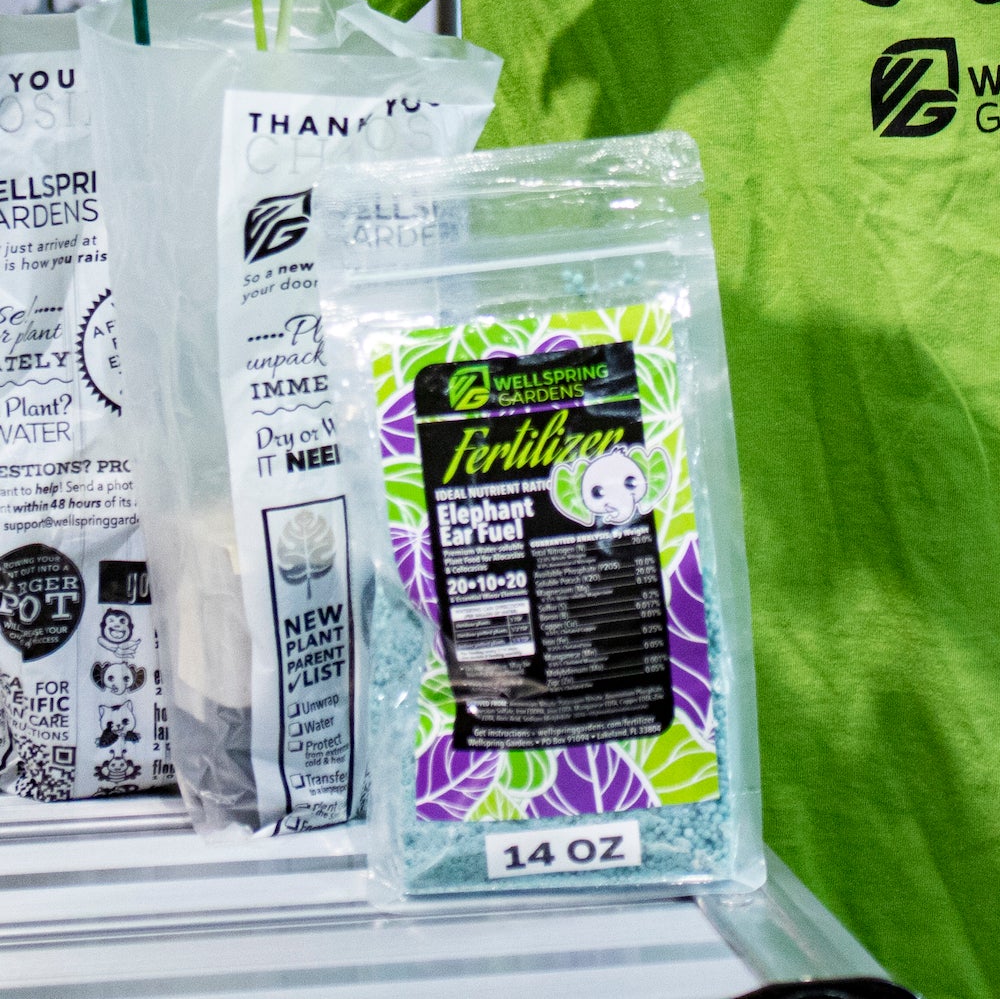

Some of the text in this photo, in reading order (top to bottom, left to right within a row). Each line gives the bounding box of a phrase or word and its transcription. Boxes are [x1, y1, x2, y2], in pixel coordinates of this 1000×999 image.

[8, 69, 75, 93] YOU
[386, 97, 440, 117] YO
[0, 170, 97, 202] ELLSPRI
[4, 234, 98, 258] just arrived at
[4, 250, 108, 272] is how you rais
[243, 260, 315, 288] So a new
[241, 283, 276, 306] your
[9, 321, 63, 355] plant
[0, 351, 71, 373] TELY
[246, 340, 328, 379] unpack
[250, 374, 329, 400] IMME
[492, 363, 609, 392] WELLSPRING
[5, 392, 73, 418] Plant?
[498, 384, 585, 407] GARDENS
[256, 426, 295, 451] Dry
[299, 429, 321, 443] or
[442, 408, 625, 485] Fertilizer
[257, 443, 342, 478] IT NEE
[21, 485, 33, 497] to
[35, 482, 63, 498] help!
[66, 480, 94, 493] Send
[97, 483, 104, 492] a
[107, 480, 134, 494] phot
[435, 488, 467, 502] IDEAL
[467, 483, 521, 499] NUTRIENT
[13, 500, 49, 514] within
[51, 499, 66, 510] 48
[68, 498, 101, 510] hours
[104, 496, 117, 508] of
[119, 496, 132, 507] its
[437, 496, 535, 530] Elephant
[440, 518, 524, 548] Ear Fuel
[0, 591, 80, 625] POT
[284, 603, 343, 639] NEW
[286, 625, 344, 658] PLANT
[287, 645, 345, 675] PARENT
[35, 680, 69, 695] FOR
[301, 693, 339, 715] Unwrap
[303, 716, 335, 734] Water
[305, 733, 342, 751] Protect
[503, 835, 626, 871] 14 OZ
